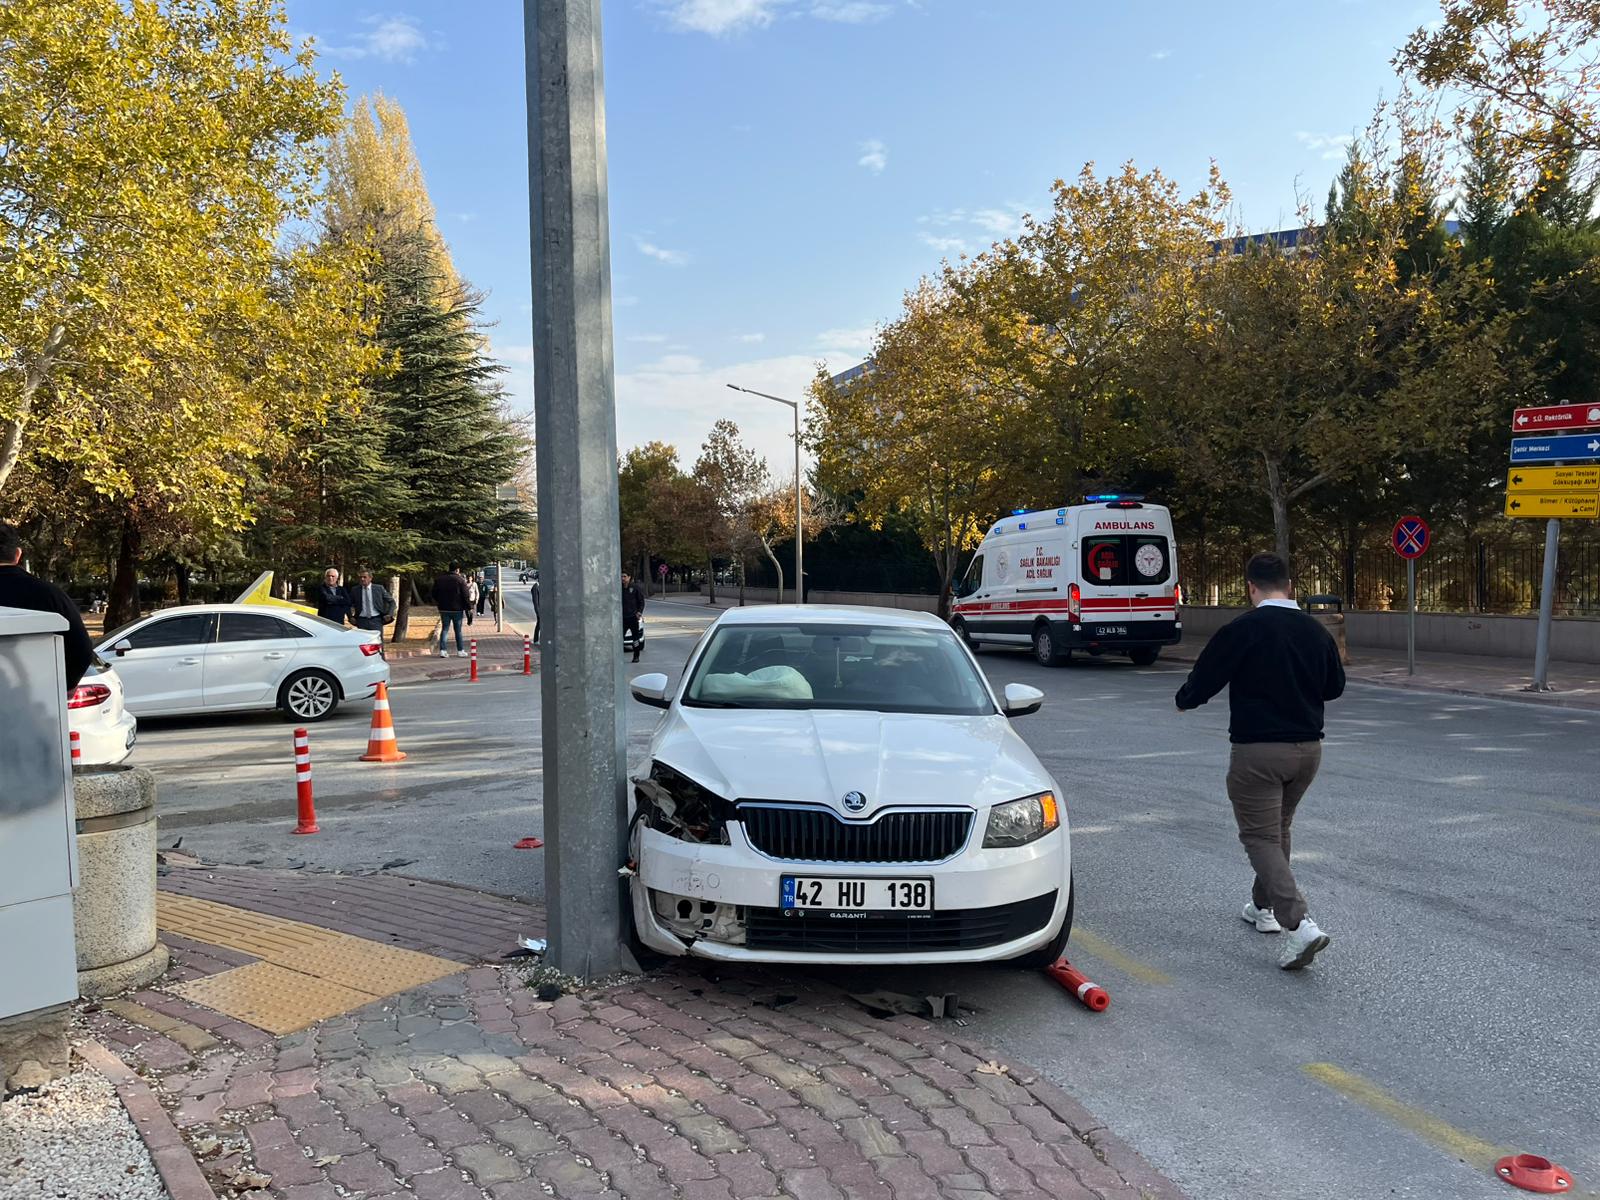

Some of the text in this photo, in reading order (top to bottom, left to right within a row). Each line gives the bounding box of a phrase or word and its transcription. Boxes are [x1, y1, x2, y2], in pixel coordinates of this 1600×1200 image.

[1094, 521, 1155, 530] AMBULANS
[784, 895, 794, 903] TR
[796, 881, 927, 908] 42 HU 138
